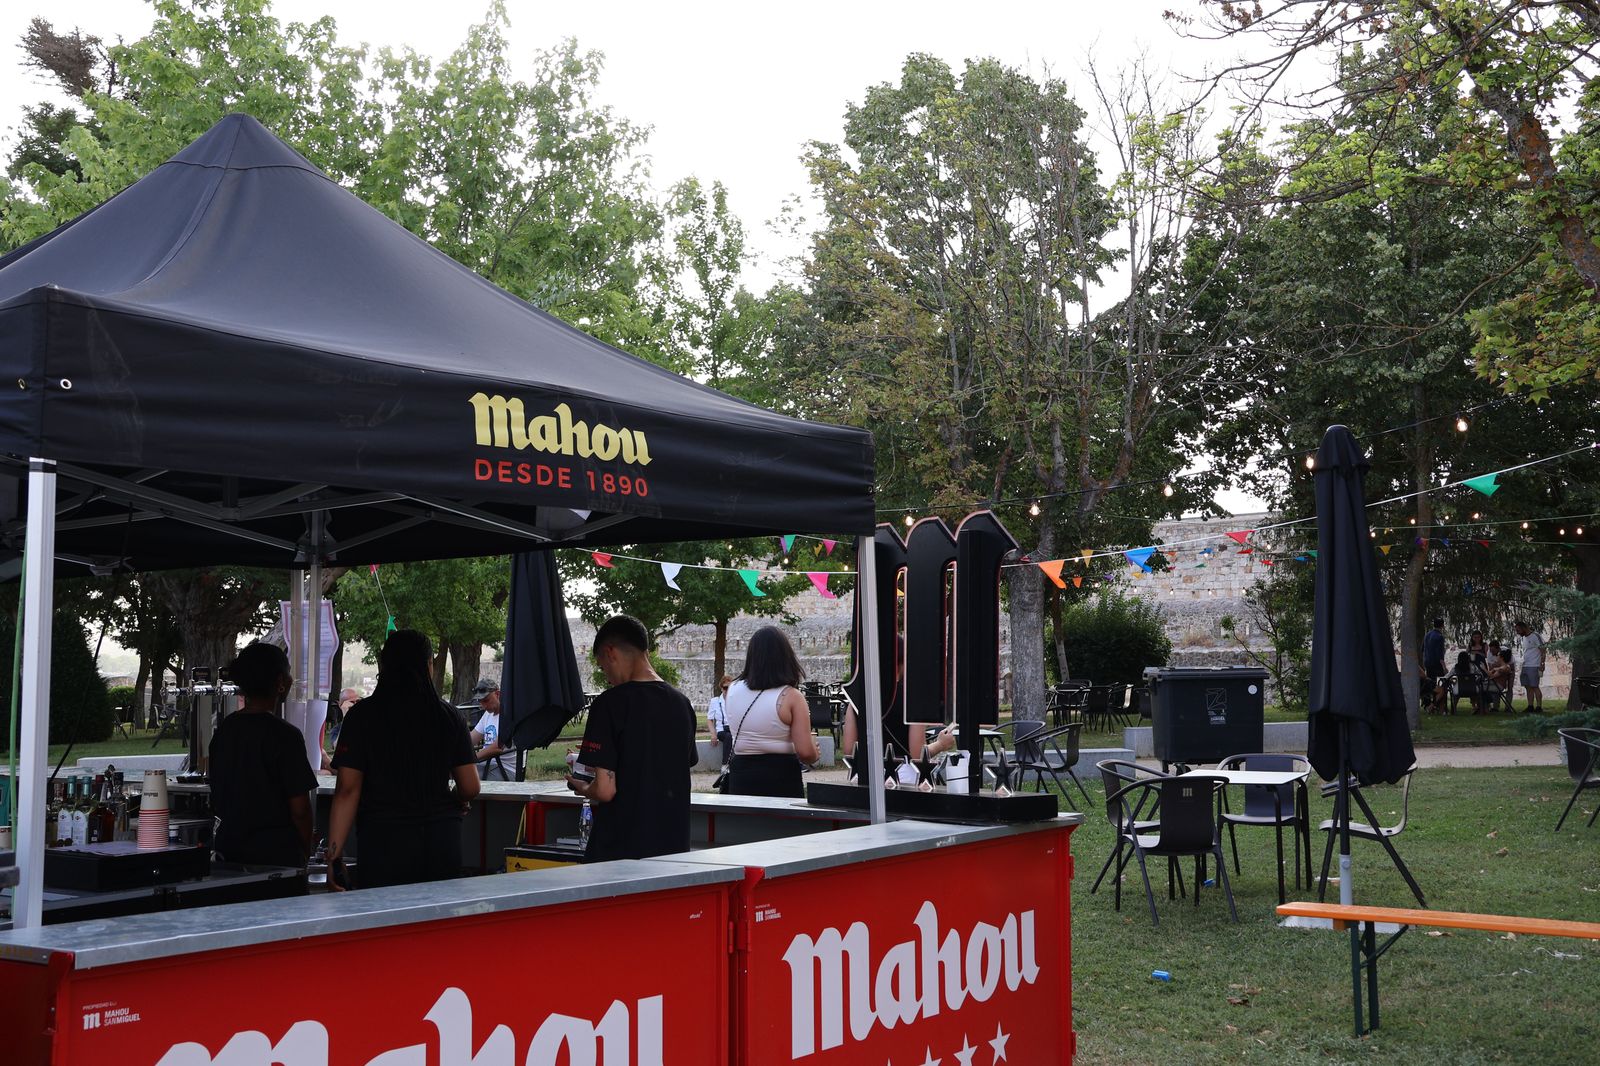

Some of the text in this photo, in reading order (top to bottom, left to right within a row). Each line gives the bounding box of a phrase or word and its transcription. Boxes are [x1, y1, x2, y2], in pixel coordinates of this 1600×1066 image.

[475, 459, 648, 497] DESDE 1890
[105, 1008, 129, 1018] MAHOU
